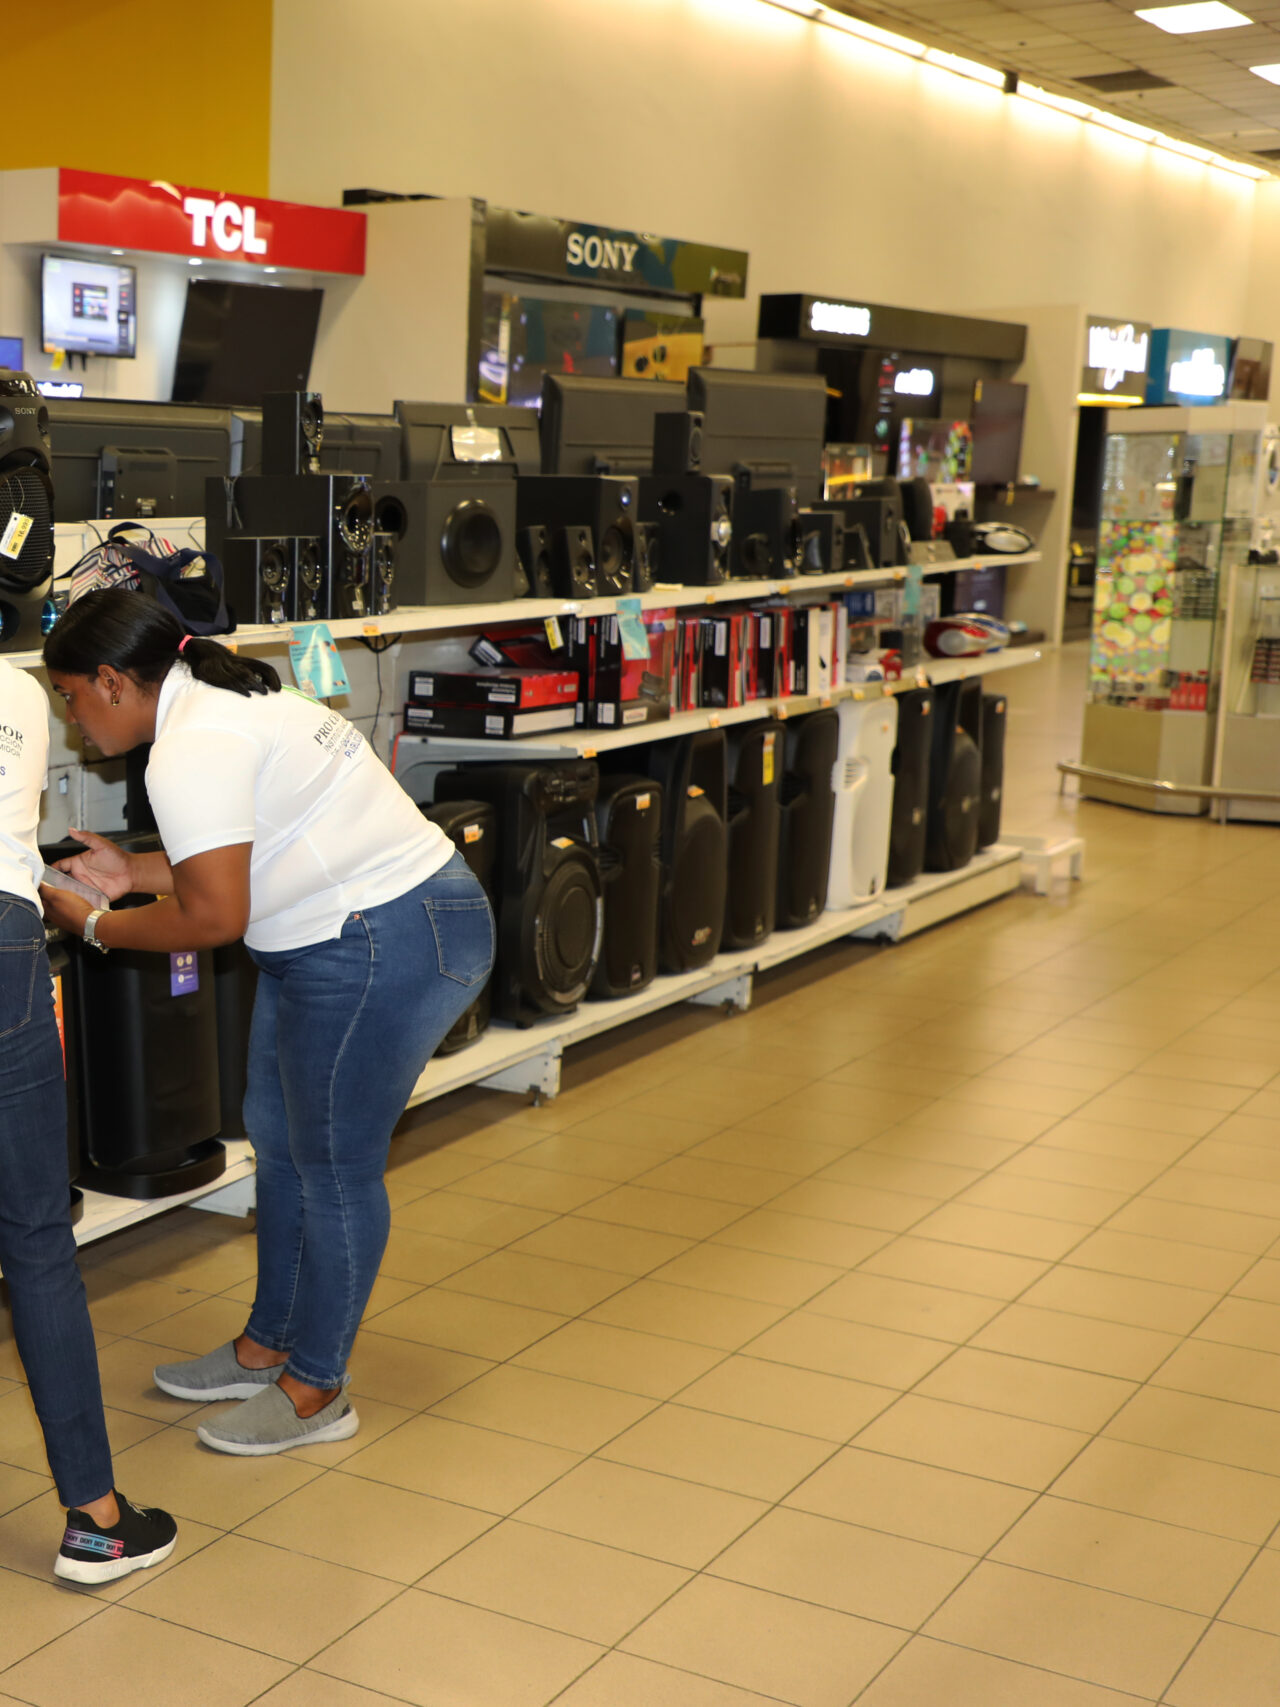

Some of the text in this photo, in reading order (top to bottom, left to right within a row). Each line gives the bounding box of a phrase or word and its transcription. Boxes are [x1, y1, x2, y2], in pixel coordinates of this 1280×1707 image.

[184, 197, 267, 254] TCL
[566, 232, 638, 272] SONY
[14, 407, 37, 416] SONY
